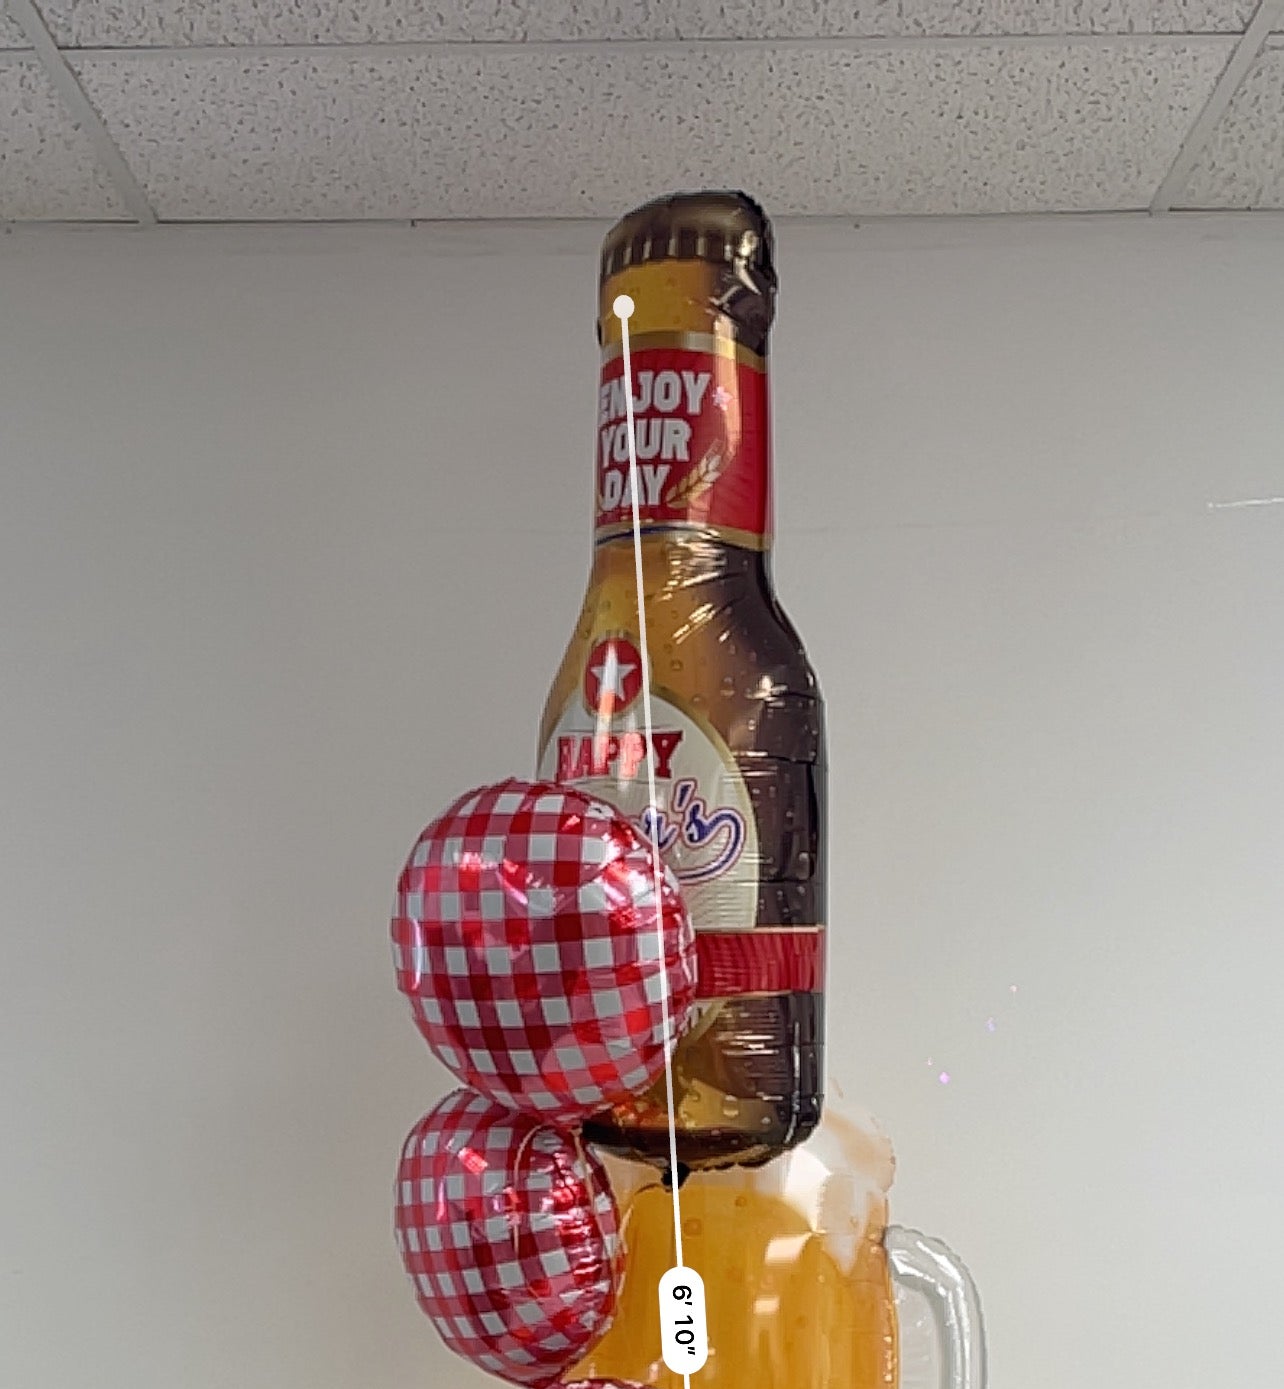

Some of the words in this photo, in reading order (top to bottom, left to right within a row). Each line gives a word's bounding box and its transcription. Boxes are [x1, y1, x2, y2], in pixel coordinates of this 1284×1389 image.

[598, 370, 712, 424] ENJOY
[600, 417, 692, 468] YOUR
[600, 464, 671, 512] DAY
[556, 731, 683, 782] HAPPY
